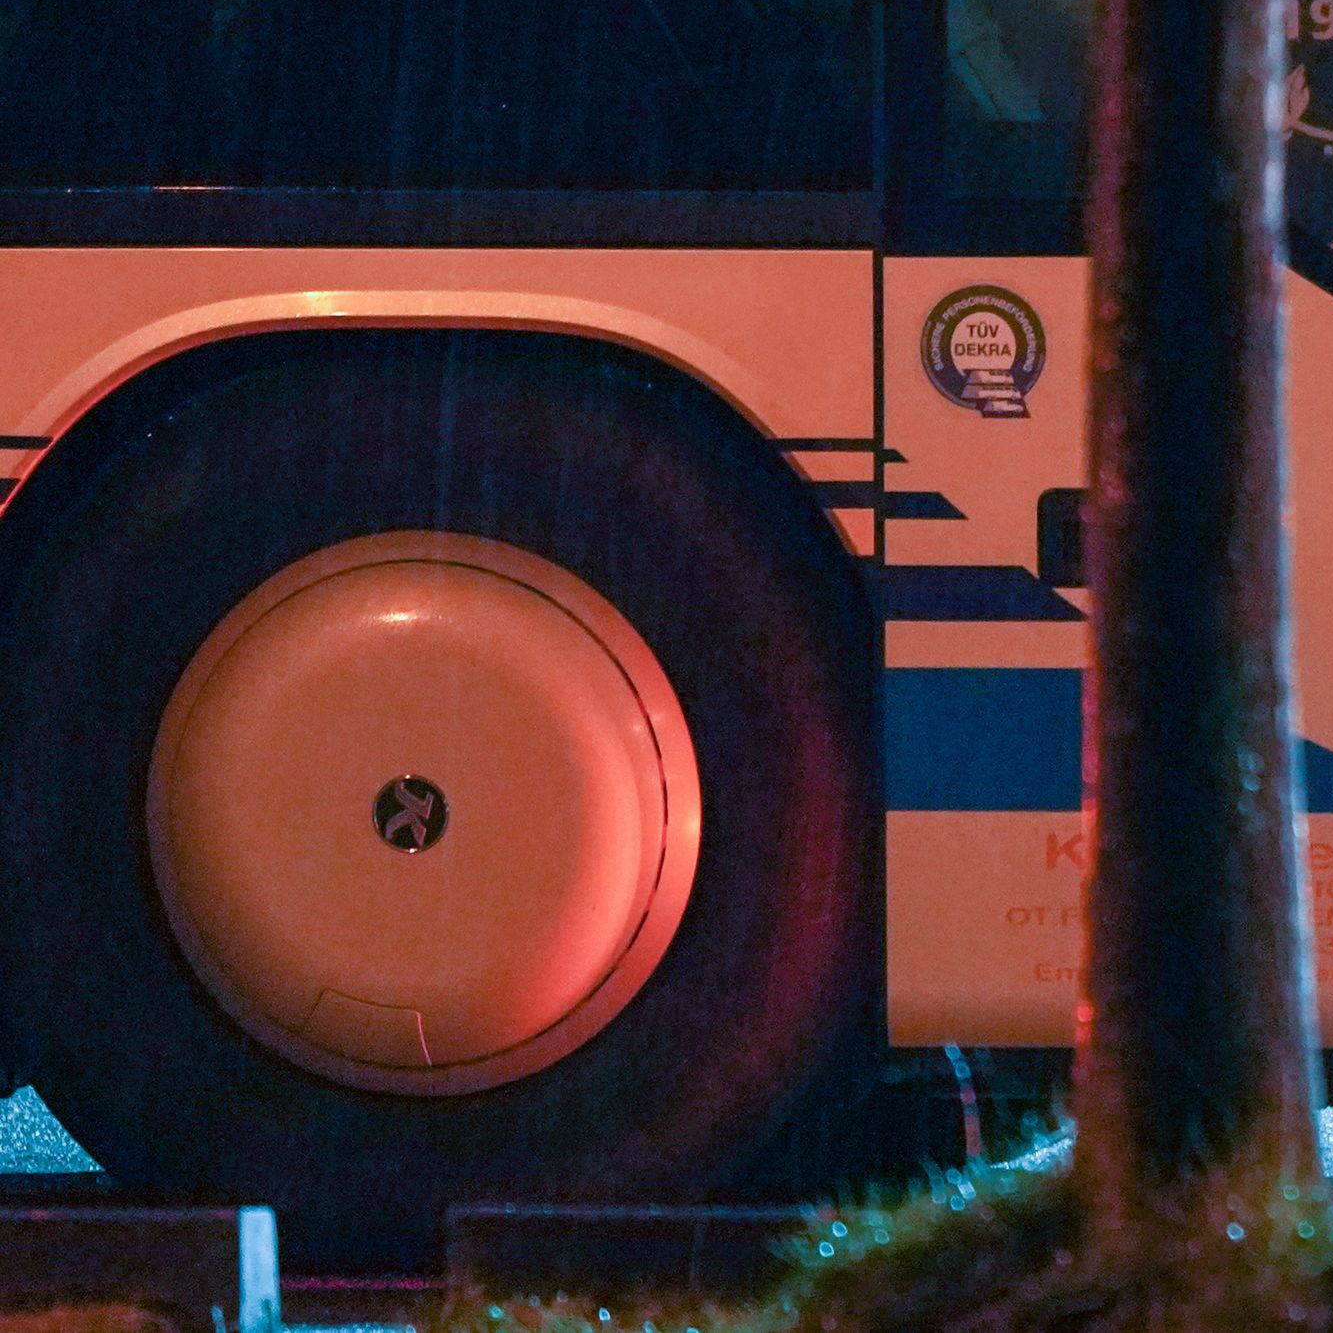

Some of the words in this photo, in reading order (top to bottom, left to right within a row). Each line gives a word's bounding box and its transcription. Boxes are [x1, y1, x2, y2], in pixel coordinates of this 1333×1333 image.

[967, 322, 999, 339] TÜV
[955, 343, 1012, 356] DEKRA
[1006, 906, 1050, 927] OT
